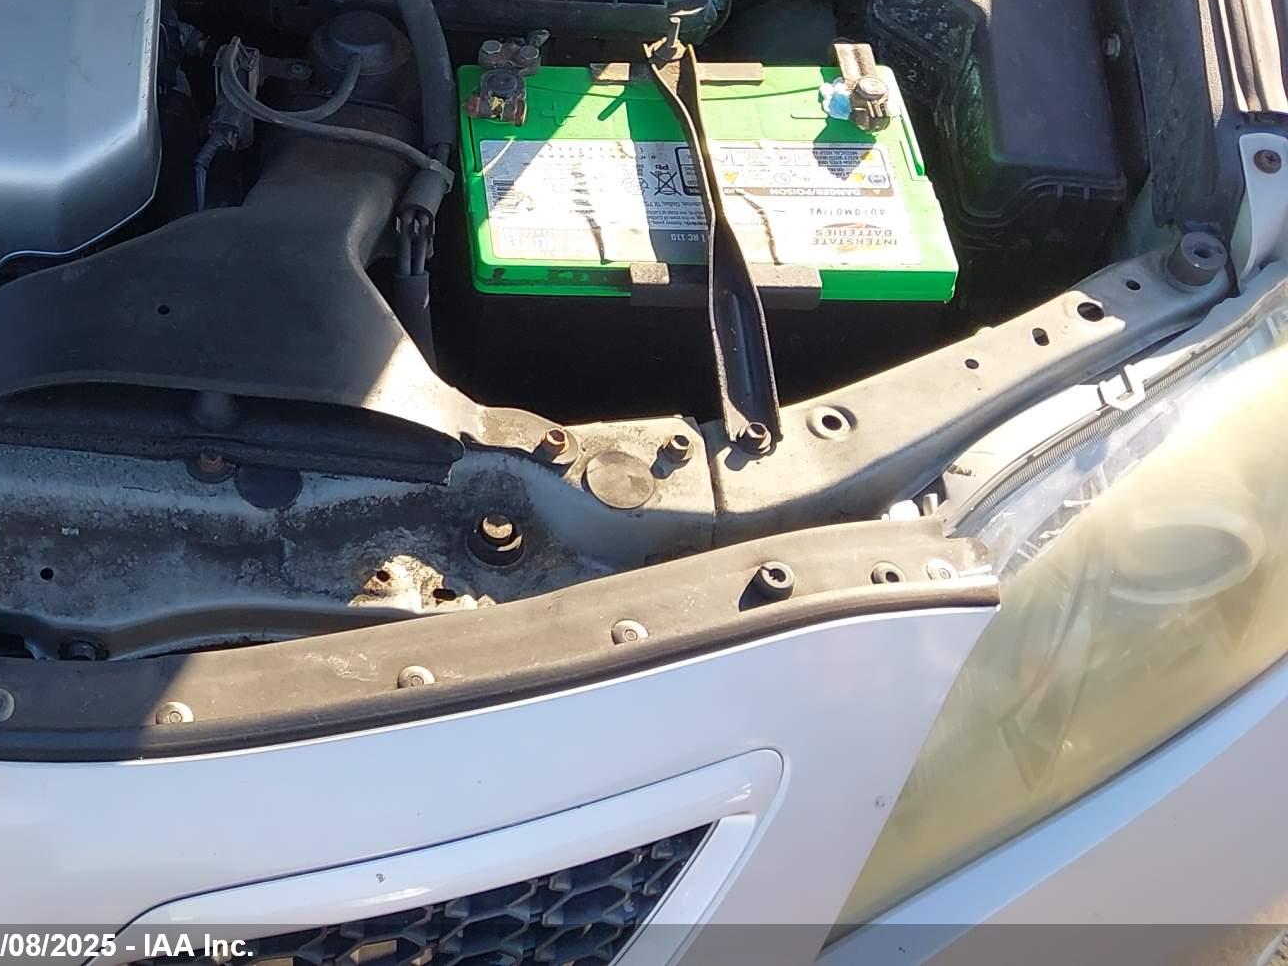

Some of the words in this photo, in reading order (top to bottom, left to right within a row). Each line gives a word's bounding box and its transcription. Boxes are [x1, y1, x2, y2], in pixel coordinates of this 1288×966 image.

[655, 163, 669, 171] Pb
[769, 187, 862, 197] DANGER/POISON
[815, 228, 893, 237] BATTERIES
[812, 237, 898, 246] INTERSTATE
